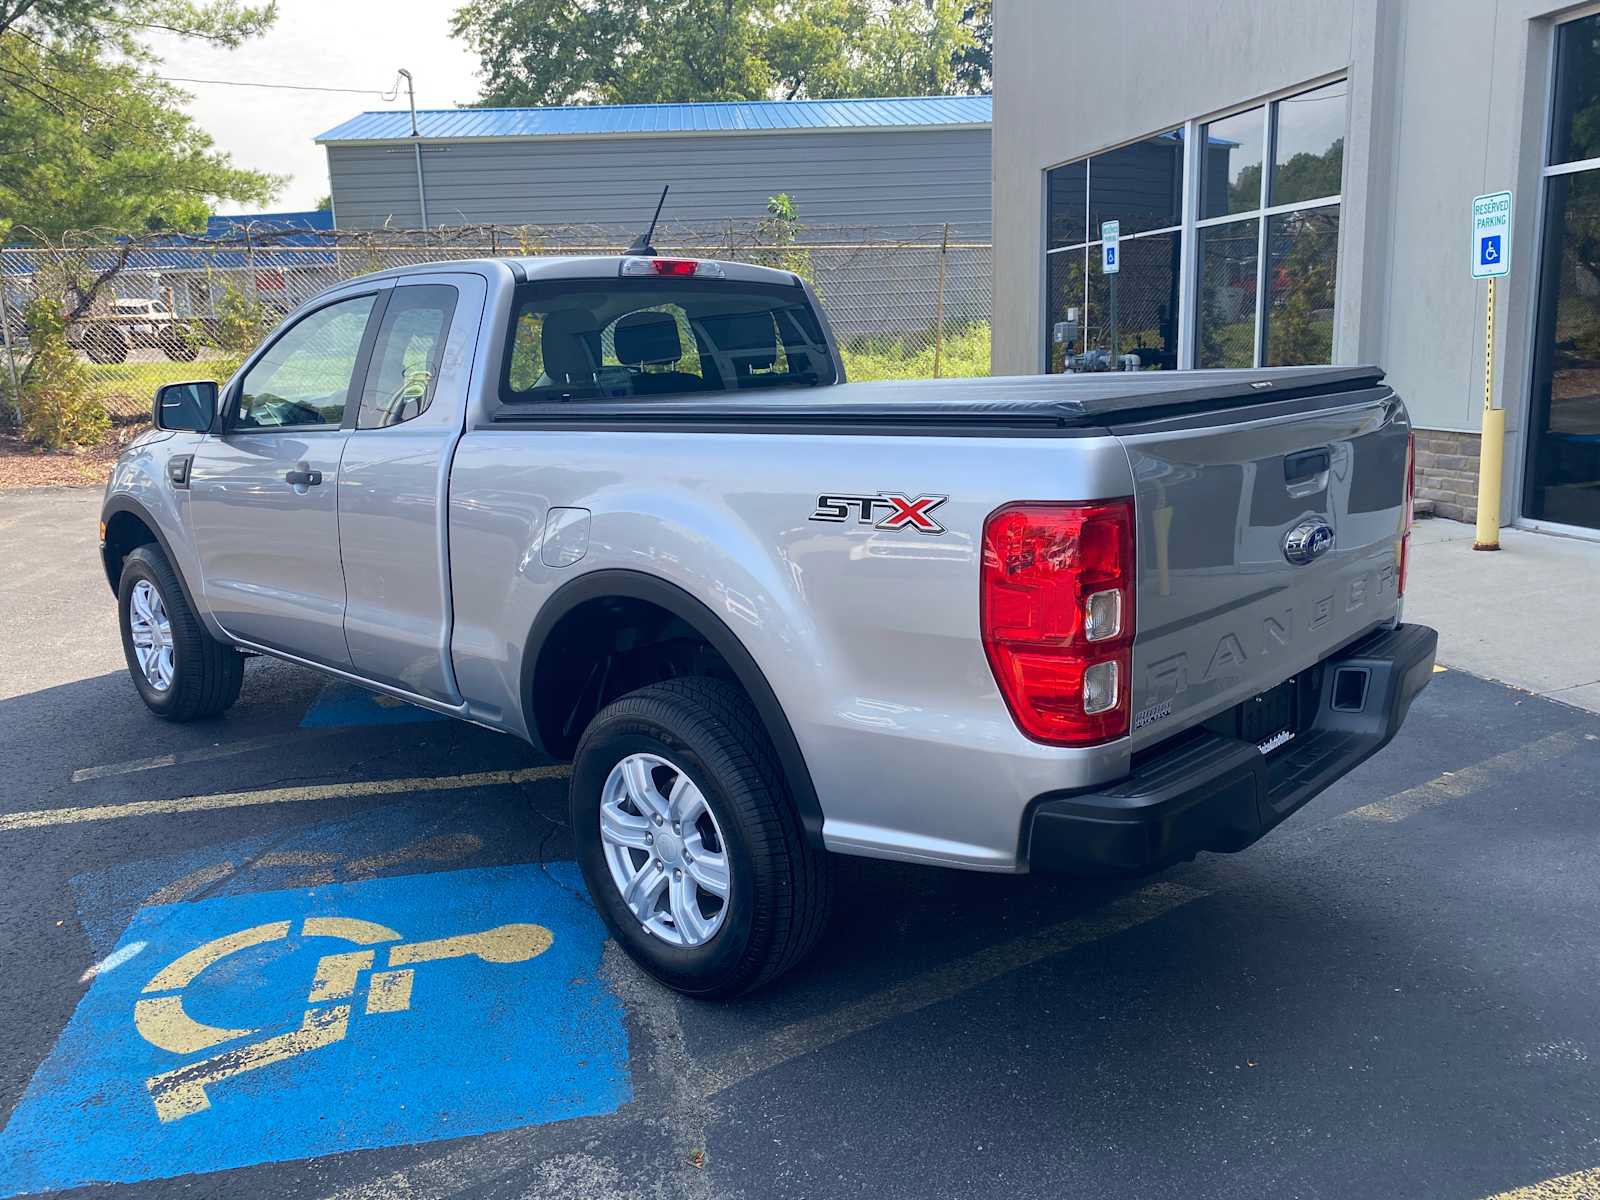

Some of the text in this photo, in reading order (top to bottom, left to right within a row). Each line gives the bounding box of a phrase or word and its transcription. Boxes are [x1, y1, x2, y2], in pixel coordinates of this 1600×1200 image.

[1475, 200, 1509, 215] RESERVED
[1477, 215, 1506, 229] PARKING
[808, 491, 949, 536] STX
[1146, 563, 1394, 703] RANGER
